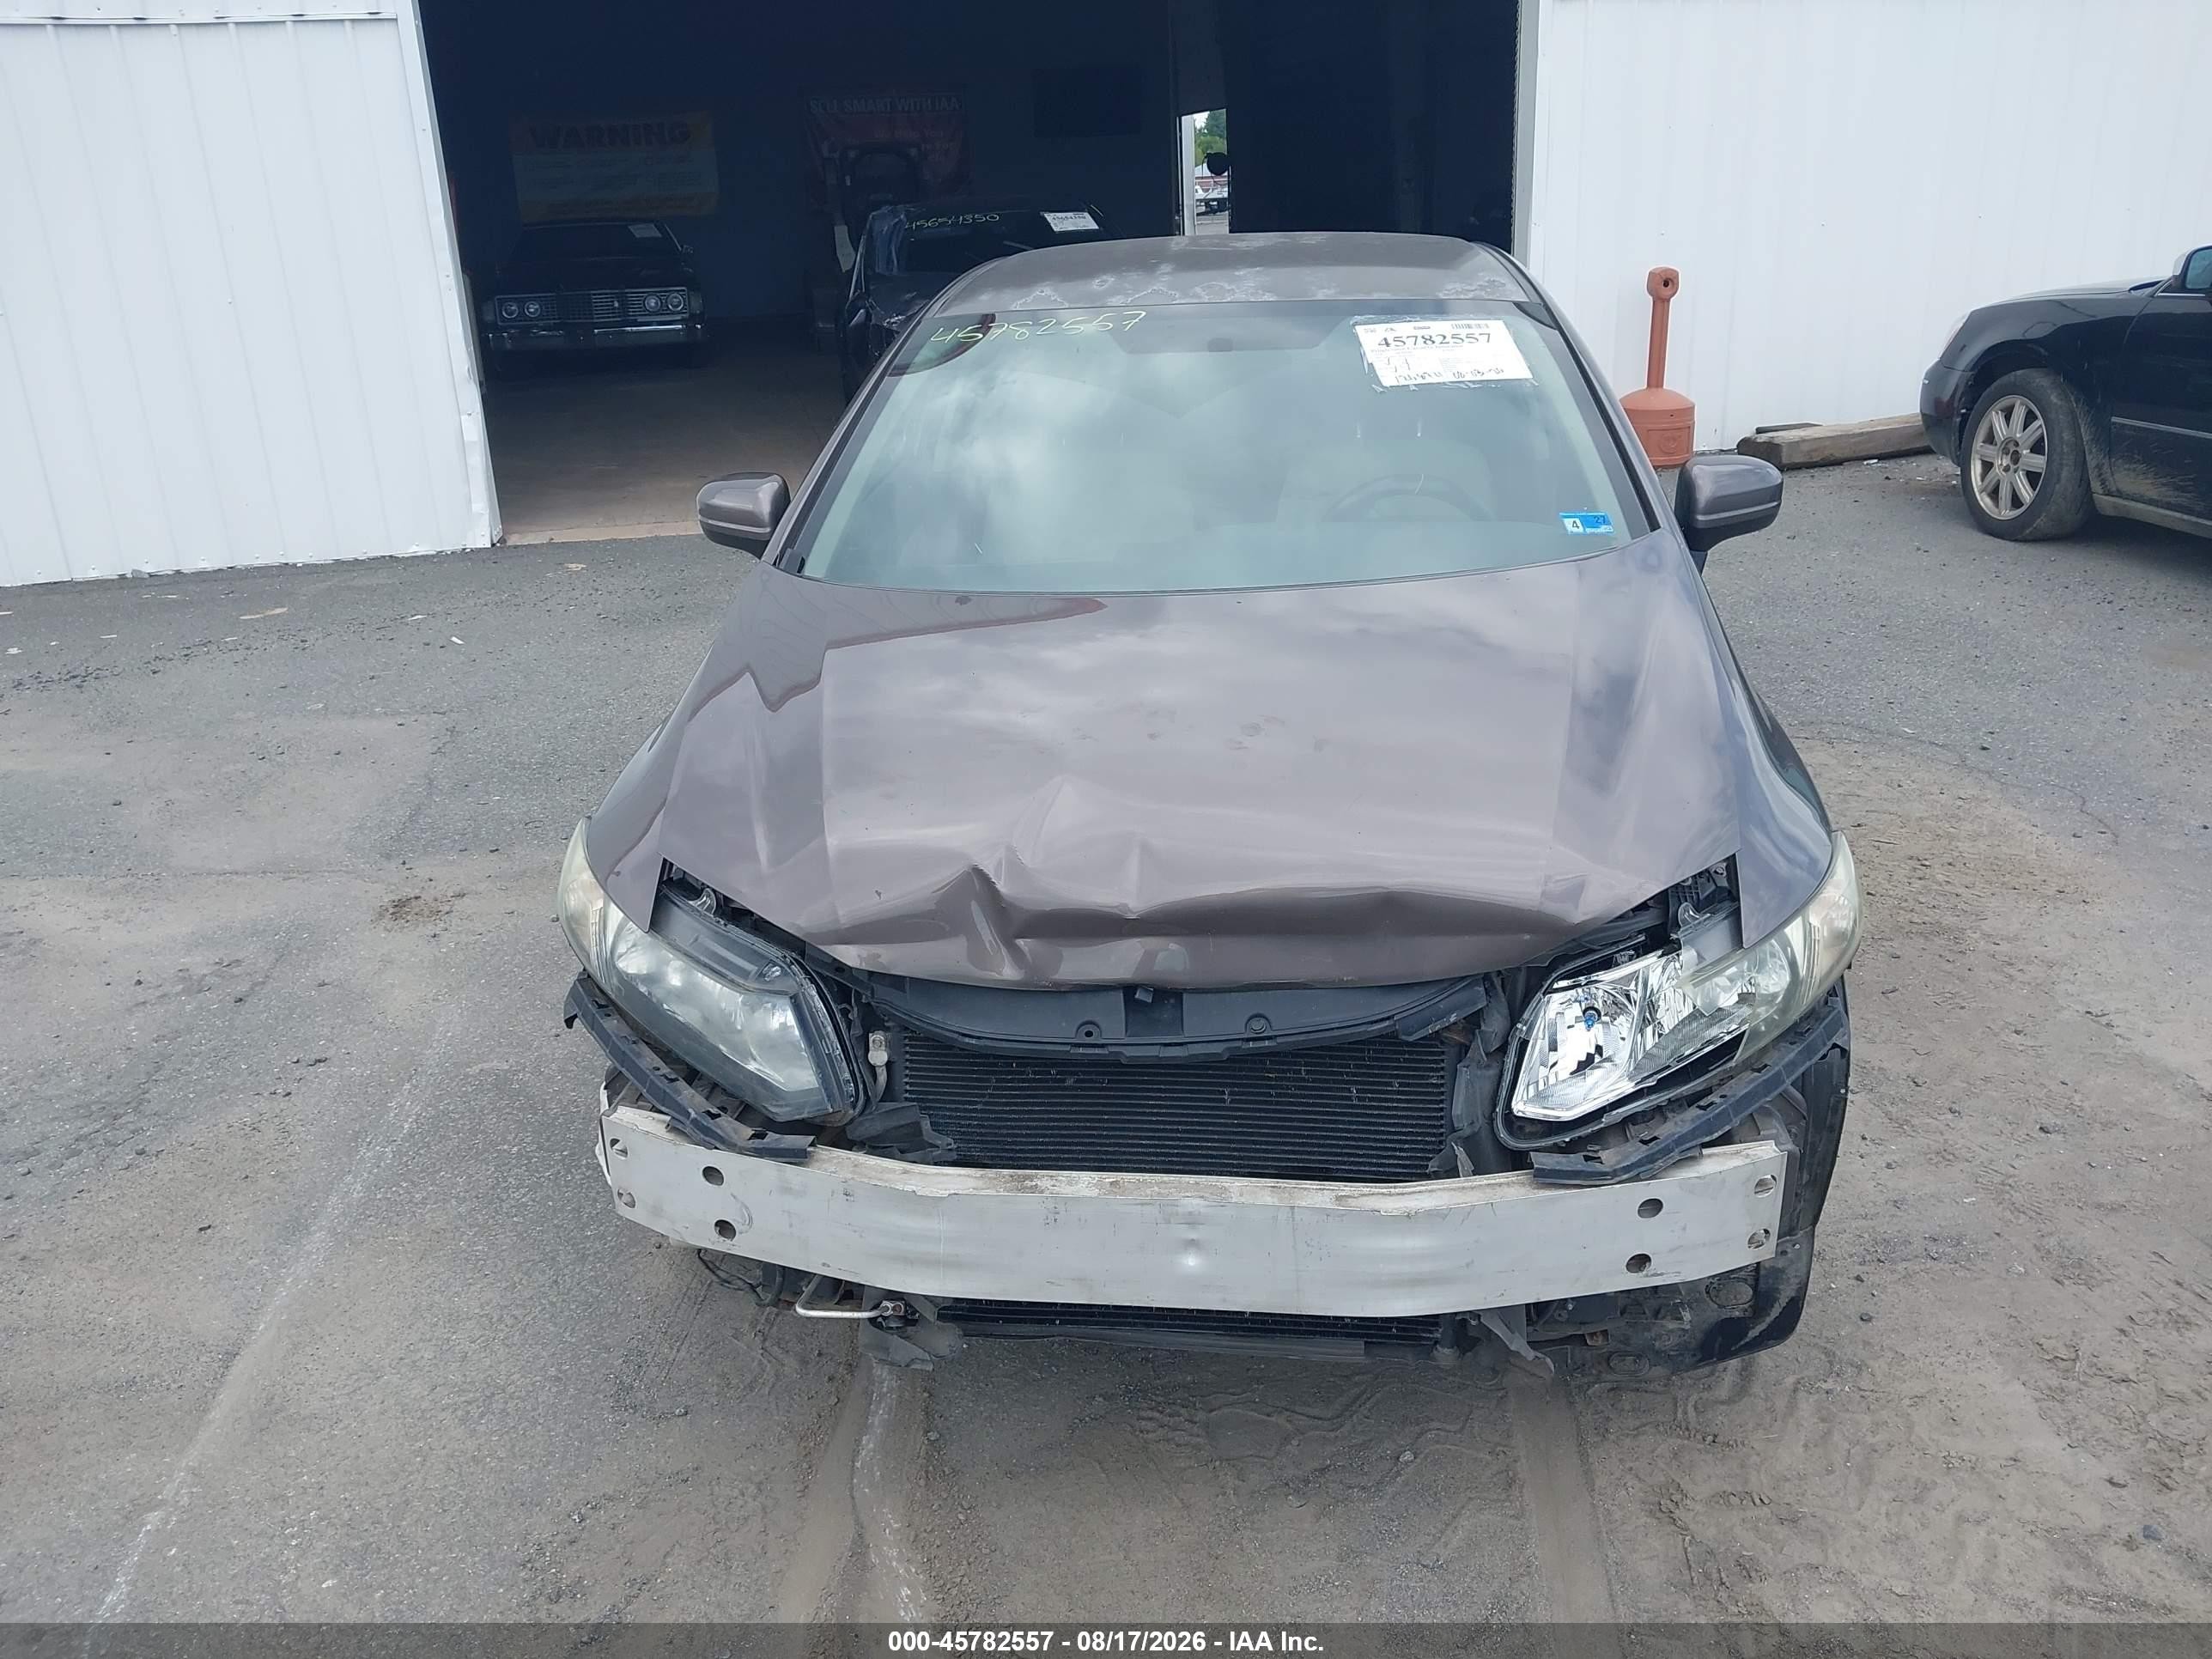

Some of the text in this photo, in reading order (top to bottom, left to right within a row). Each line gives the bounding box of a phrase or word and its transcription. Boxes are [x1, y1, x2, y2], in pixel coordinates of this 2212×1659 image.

[844, 97, 892, 112] SMART
[896, 96, 931, 112] WITH
[935, 96, 961, 111] IAA
[528, 121, 693, 149] WARNING
[930, 310, 1146, 343] 45782557
[1378, 332, 1492, 348] 45782557
[1571, 520, 1580, 530] 4
